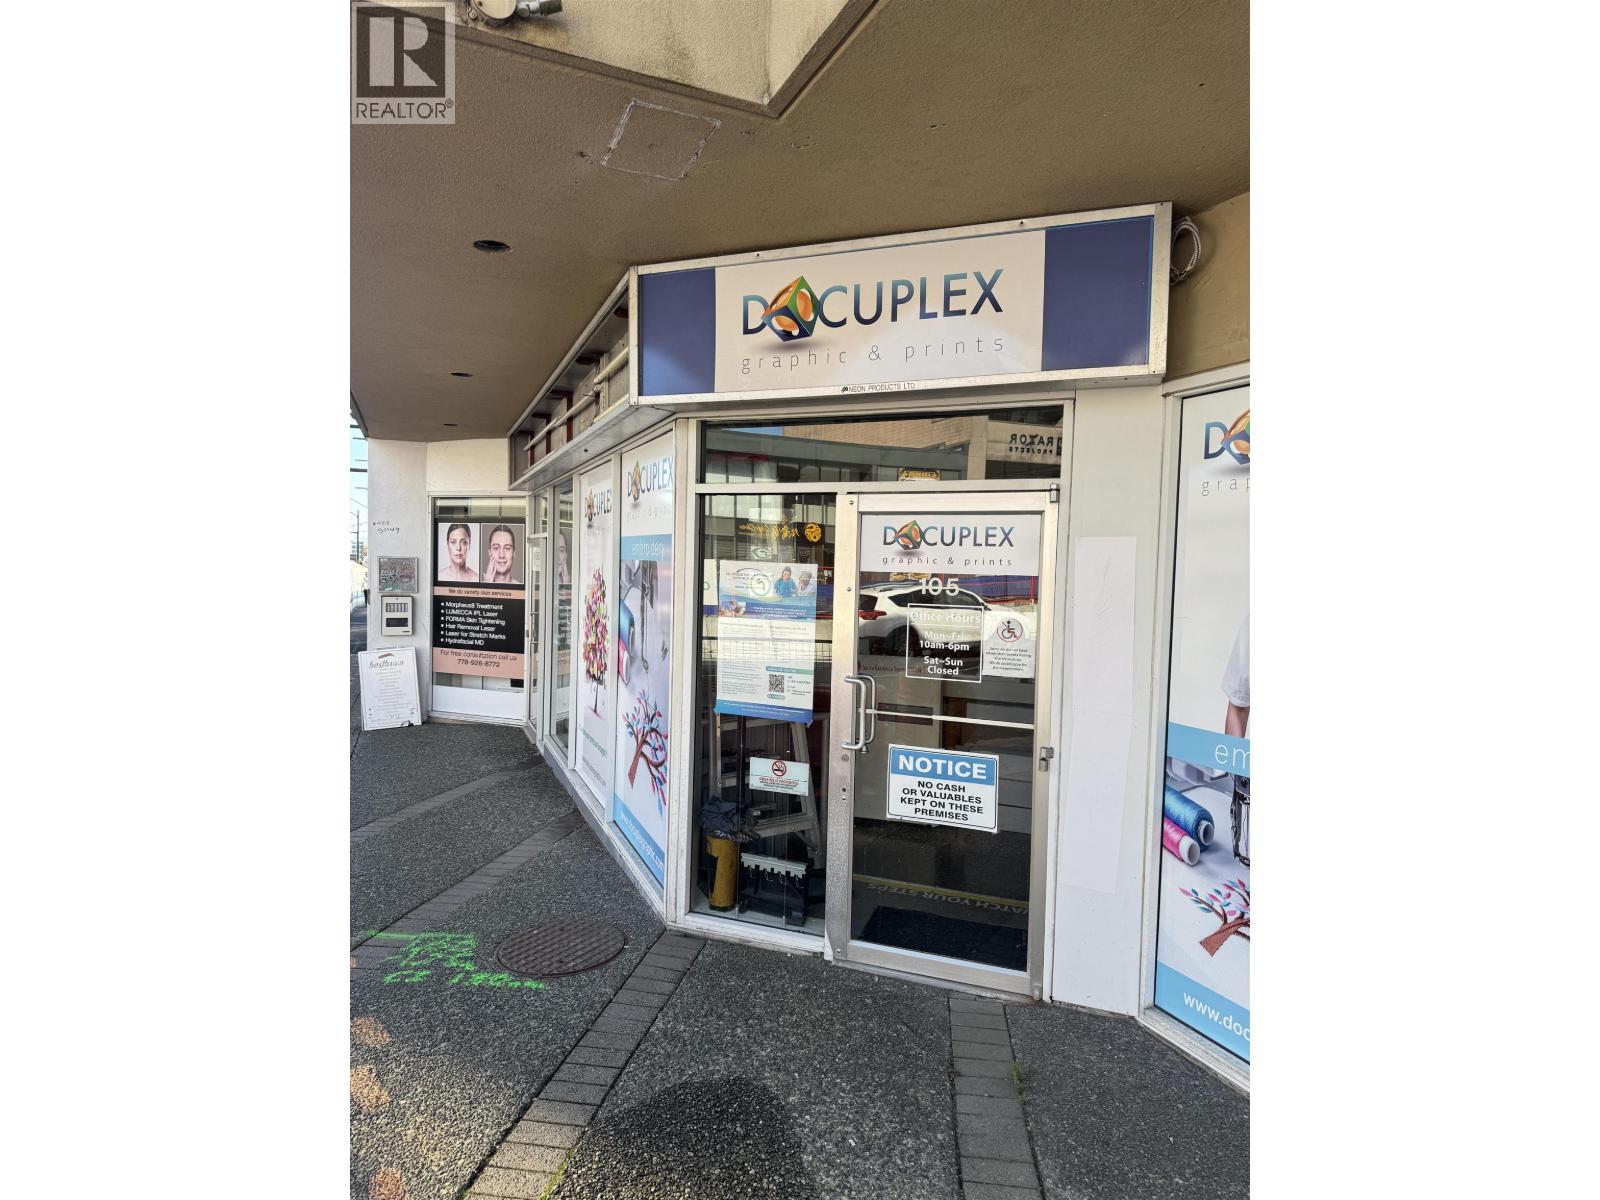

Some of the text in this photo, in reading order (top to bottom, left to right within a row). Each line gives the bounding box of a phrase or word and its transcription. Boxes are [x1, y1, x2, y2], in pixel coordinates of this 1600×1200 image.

[741, 336, 1004, 375] graphic & prints
[867, 383, 902, 392] PRODUCTS
[882, 556, 1013, 567] graphic & prints
[918, 577, 960, 596] 105
[476, 602, 503, 610] Treatment
[478, 618, 506, 626] Tightening
[911, 610, 981, 623] Office Hours
[920, 640, 970, 652] 10am-6pm
[463, 652, 497, 660] consultation
[923, 656, 964, 667] Sat~Sun
[457, 659, 501, 668] 778-926-8772
[927, 665, 959, 675] Closed
[898, 754, 987, 780] NOTICE
[917, 781, 966, 793] NO CASH
[902, 787, 982, 804] OR VALUABLES
[900, 796, 984, 814] KEPT ON THESE
[914, 807, 969, 821] PREMISES
[922, 891, 974, 908] YOUR
